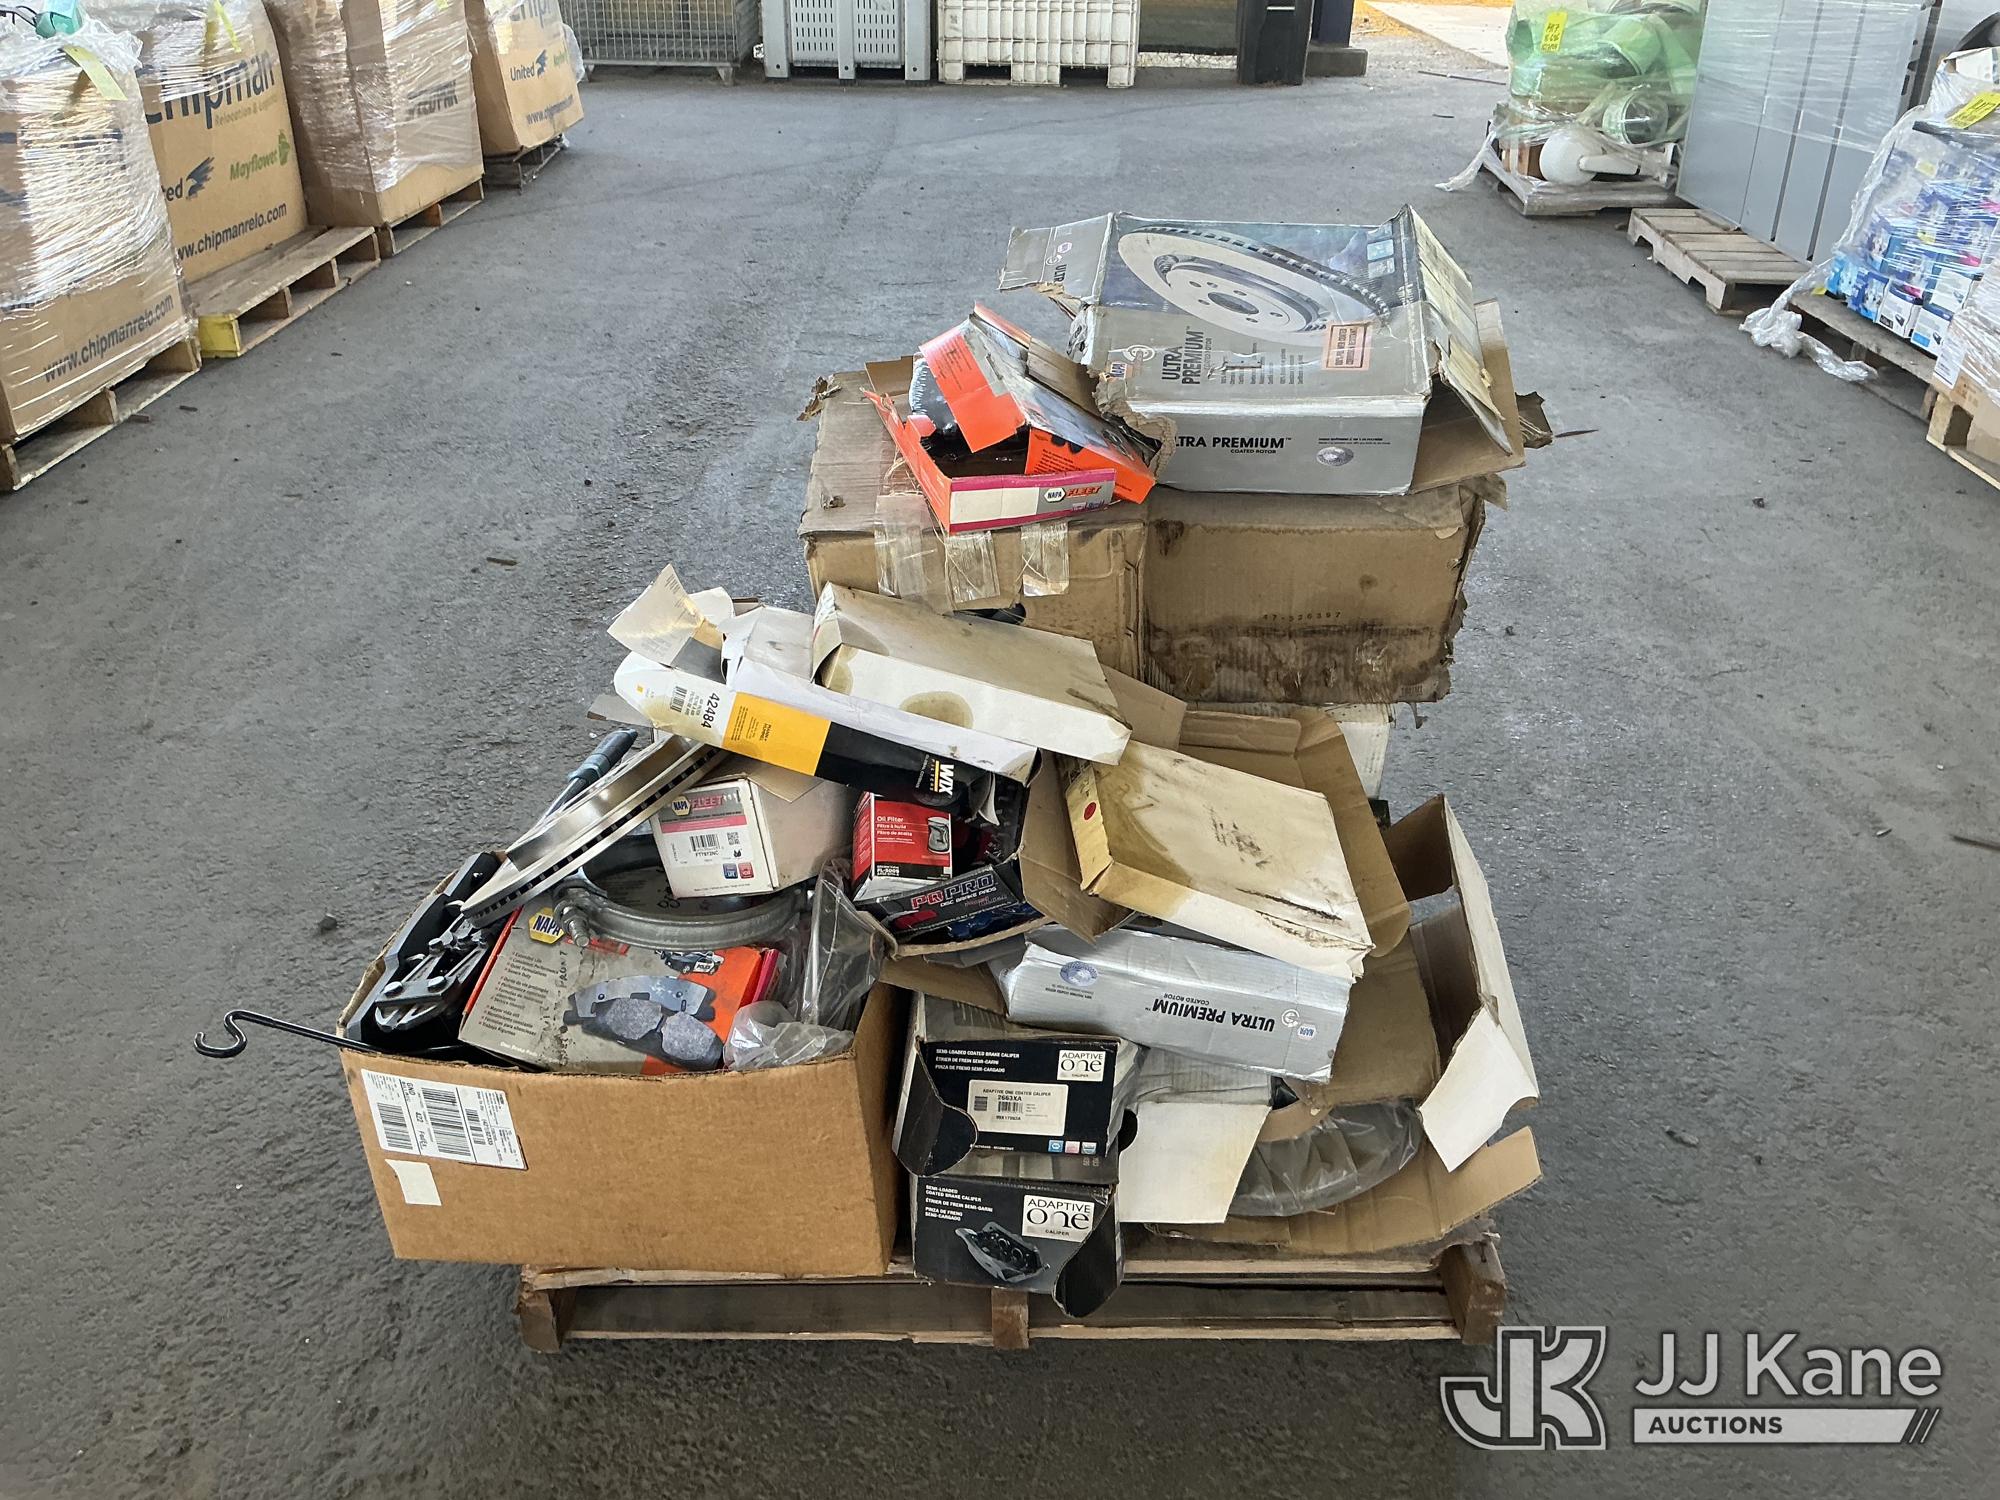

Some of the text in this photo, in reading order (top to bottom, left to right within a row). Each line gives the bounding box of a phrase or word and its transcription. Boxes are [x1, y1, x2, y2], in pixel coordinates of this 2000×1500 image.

[510, 63, 536, 82] United
[230, 150, 278, 181] Mayflower
[1161, 346, 1183, 380] ULTRA
[1174, 436, 1207, 448] LTRA
[1046, 490, 1062, 499] NAPA
[701, 692, 721, 729] 42484
[939, 764, 954, 796] WIX
[673, 795, 723, 811] NAPA FLEET
[955, 893, 978, 902] BRAKE
[533, 914, 560, 936] NAPA
[1163, 993, 1210, 1006] COATED ROTOR
[1231, 1012, 1275, 1032] ULTRA
[1062, 1052, 1104, 1060] ADAPTIVE
[1061, 1059, 1102, 1072] one
[406, 1082, 416, 1096] GND
[1027, 1198, 1091, 1213] ADAPTIVE
[1026, 1207, 1090, 1230] one
[1045, 1228, 1070, 1236] CALIPER
